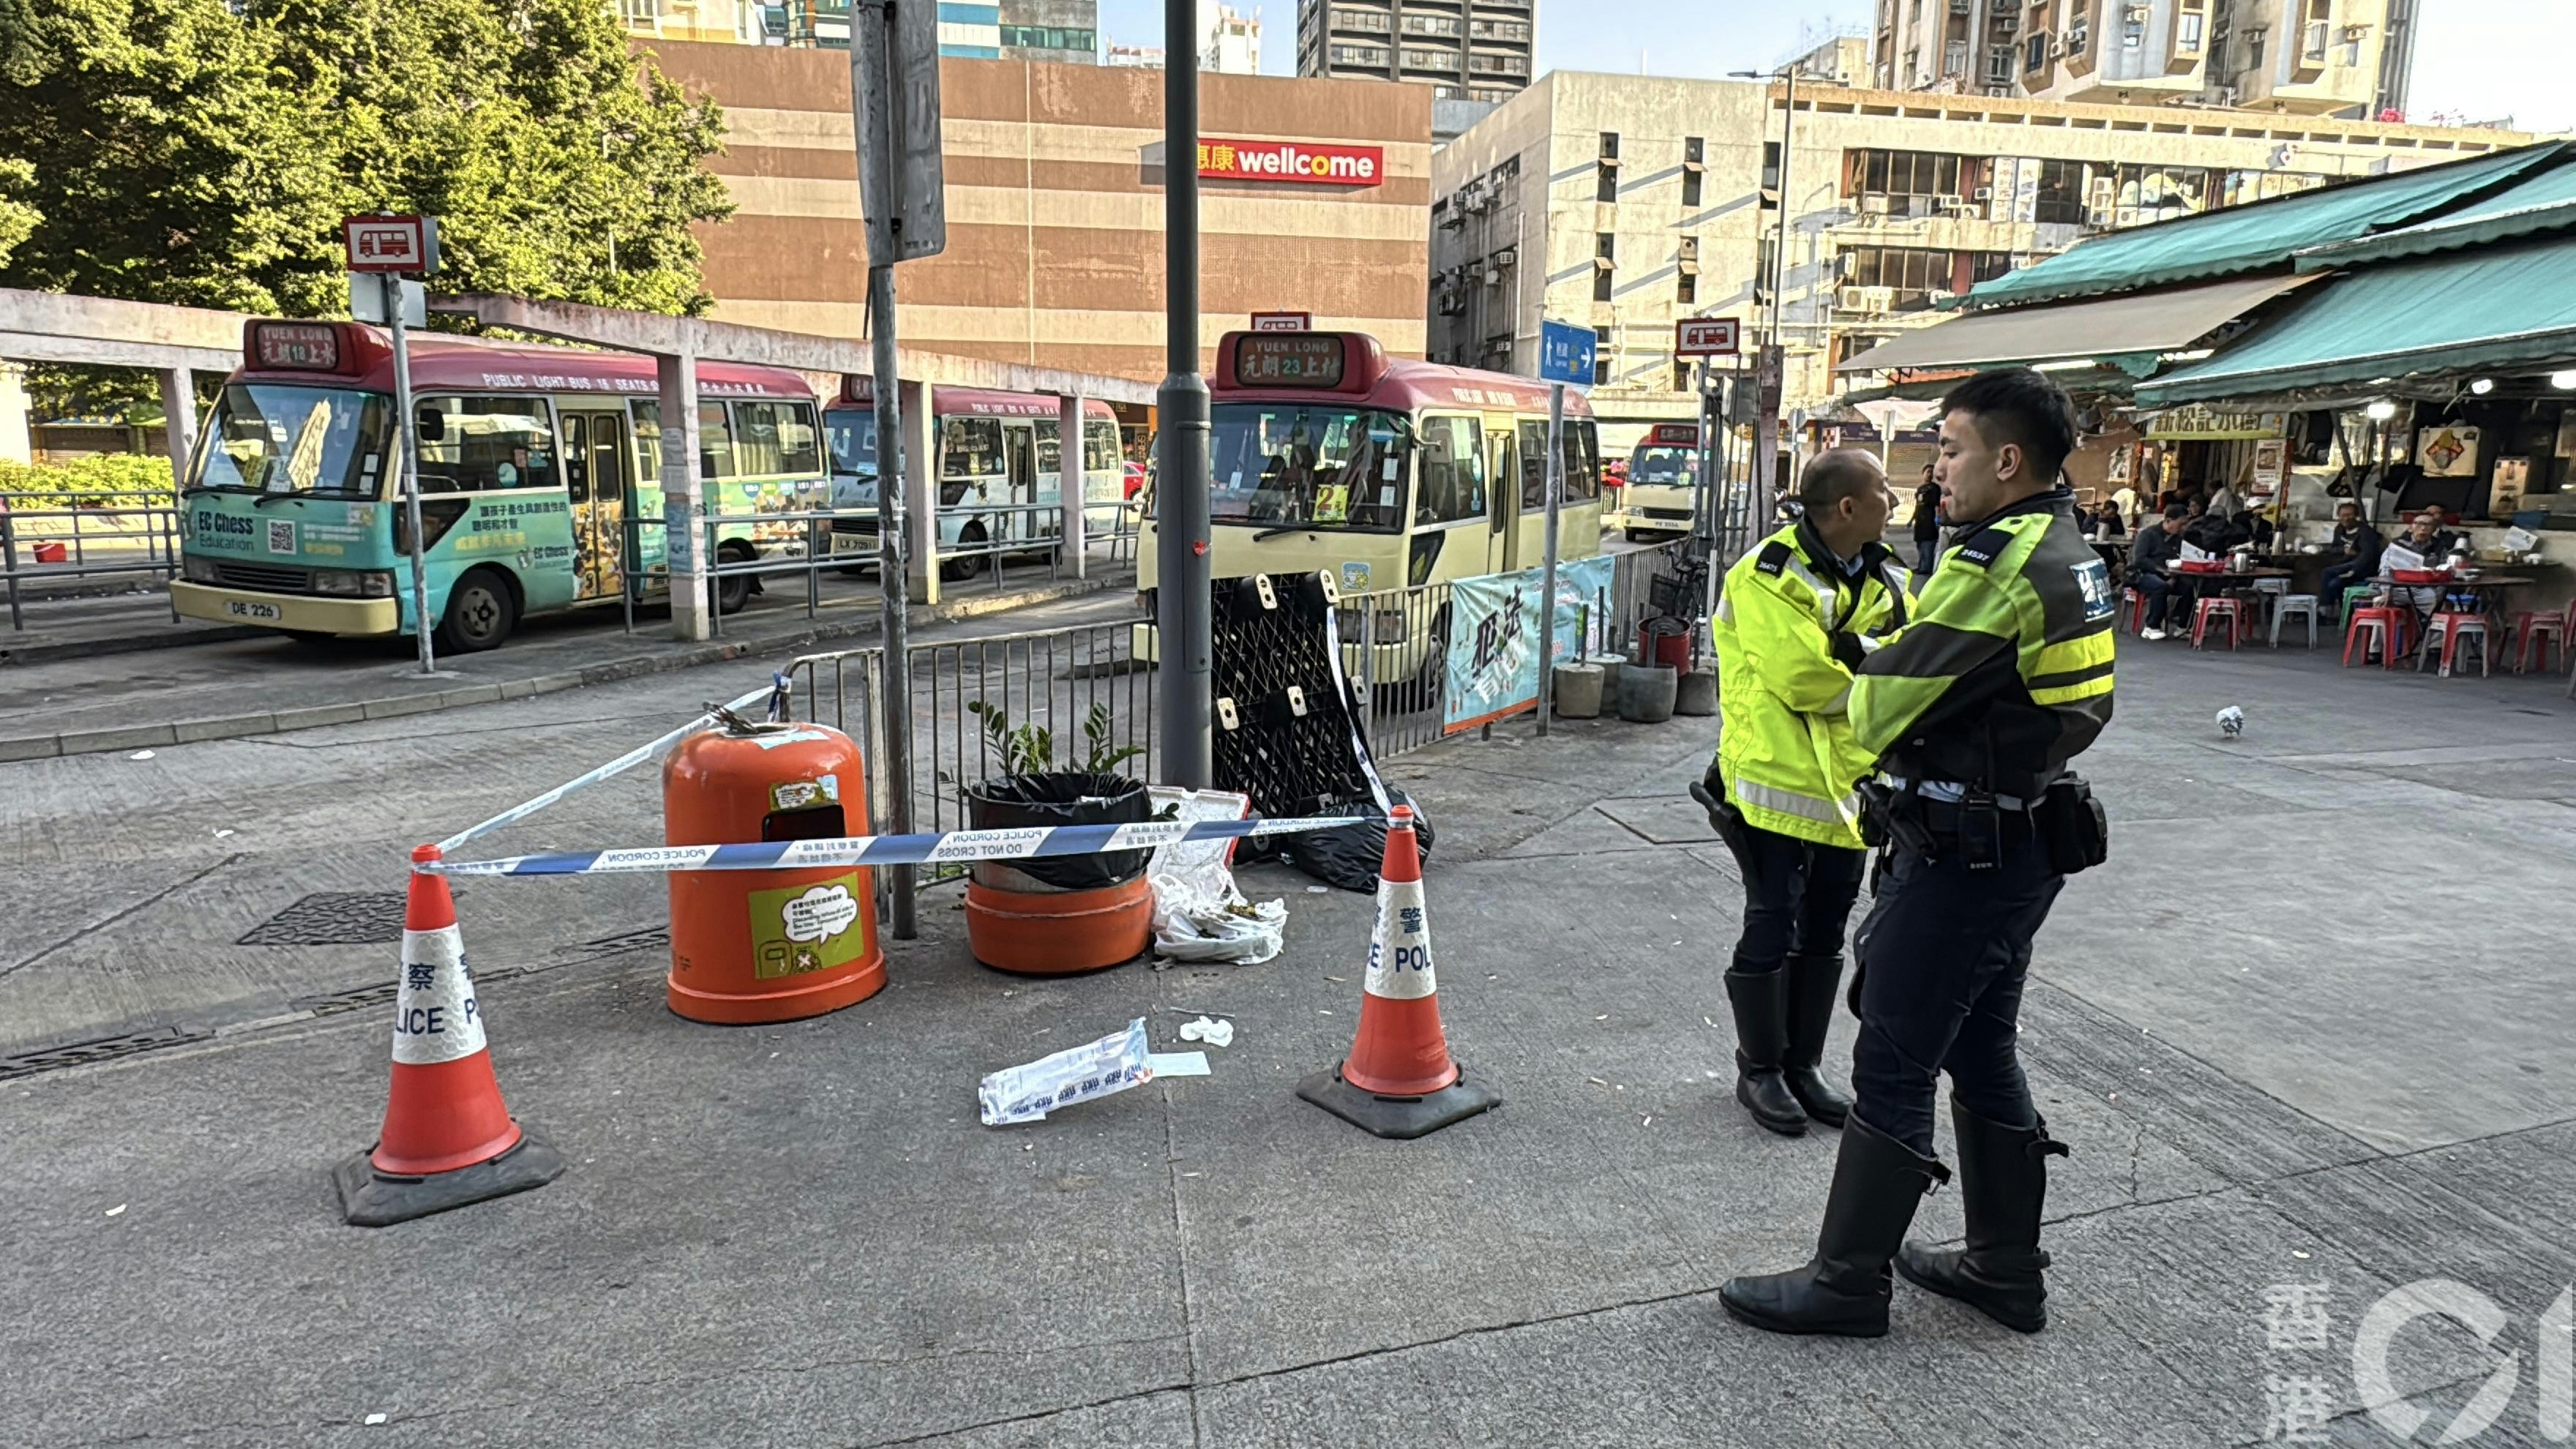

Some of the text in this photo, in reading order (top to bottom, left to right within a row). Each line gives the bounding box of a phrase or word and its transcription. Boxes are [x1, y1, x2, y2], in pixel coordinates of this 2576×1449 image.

[1198, 143, 1235, 171] 惠康
[1238, 147, 1374, 178] wellcome
[263, 328, 332, 341] YUEN LONG
[1256, 341, 1329, 353] YUEN LONG
[482, 373, 526, 388] PUBLIC
[533, 375, 566, 389] LIGHT
[568, 377, 591, 390] BUS
[615, 379, 648, 392] SEATS
[198, 512, 254, 535] EC Chess
[199, 534, 255, 550] Education
[232, 602, 274, 617] DE 226
[1399, 907, 1423, 934] 警
